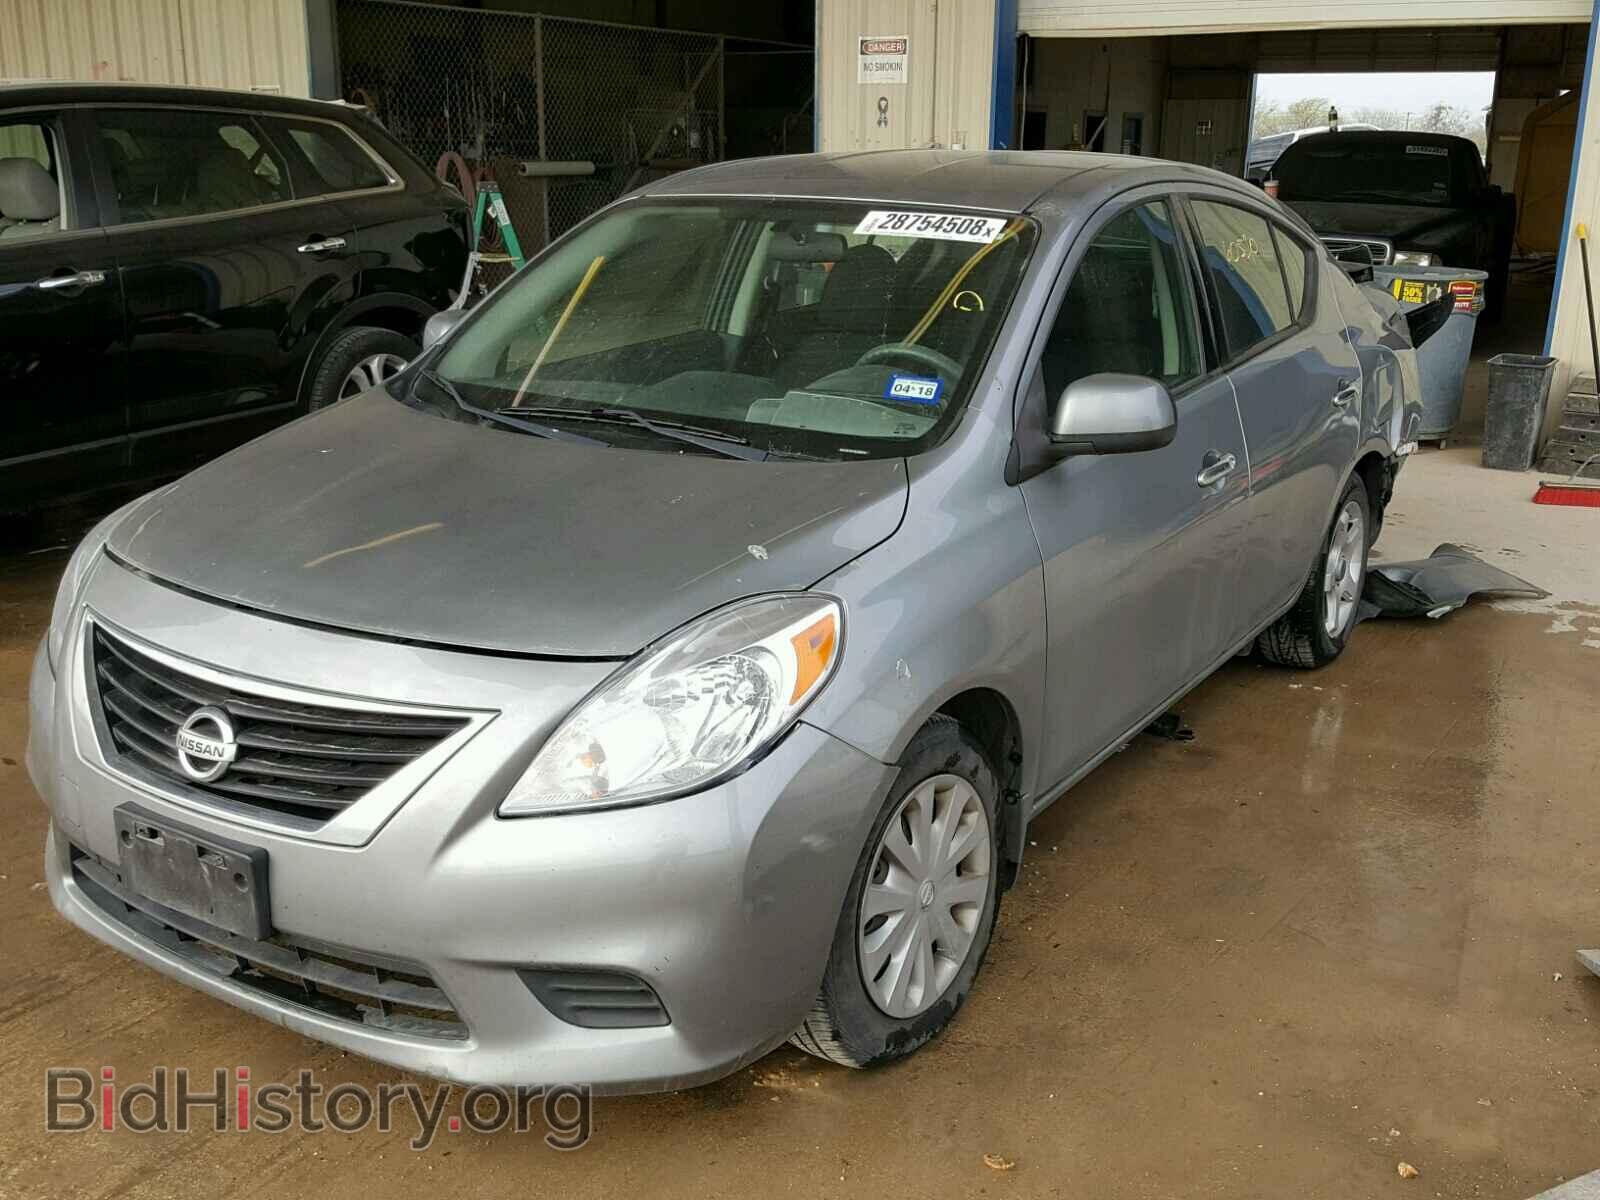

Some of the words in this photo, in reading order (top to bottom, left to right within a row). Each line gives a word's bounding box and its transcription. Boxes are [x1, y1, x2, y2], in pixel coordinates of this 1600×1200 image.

[868, 42, 902, 51] DANGER
[863, 62, 873, 72] NO
[1403, 286, 1423, 298] 50%
[179, 732, 225, 758] NISSAN
